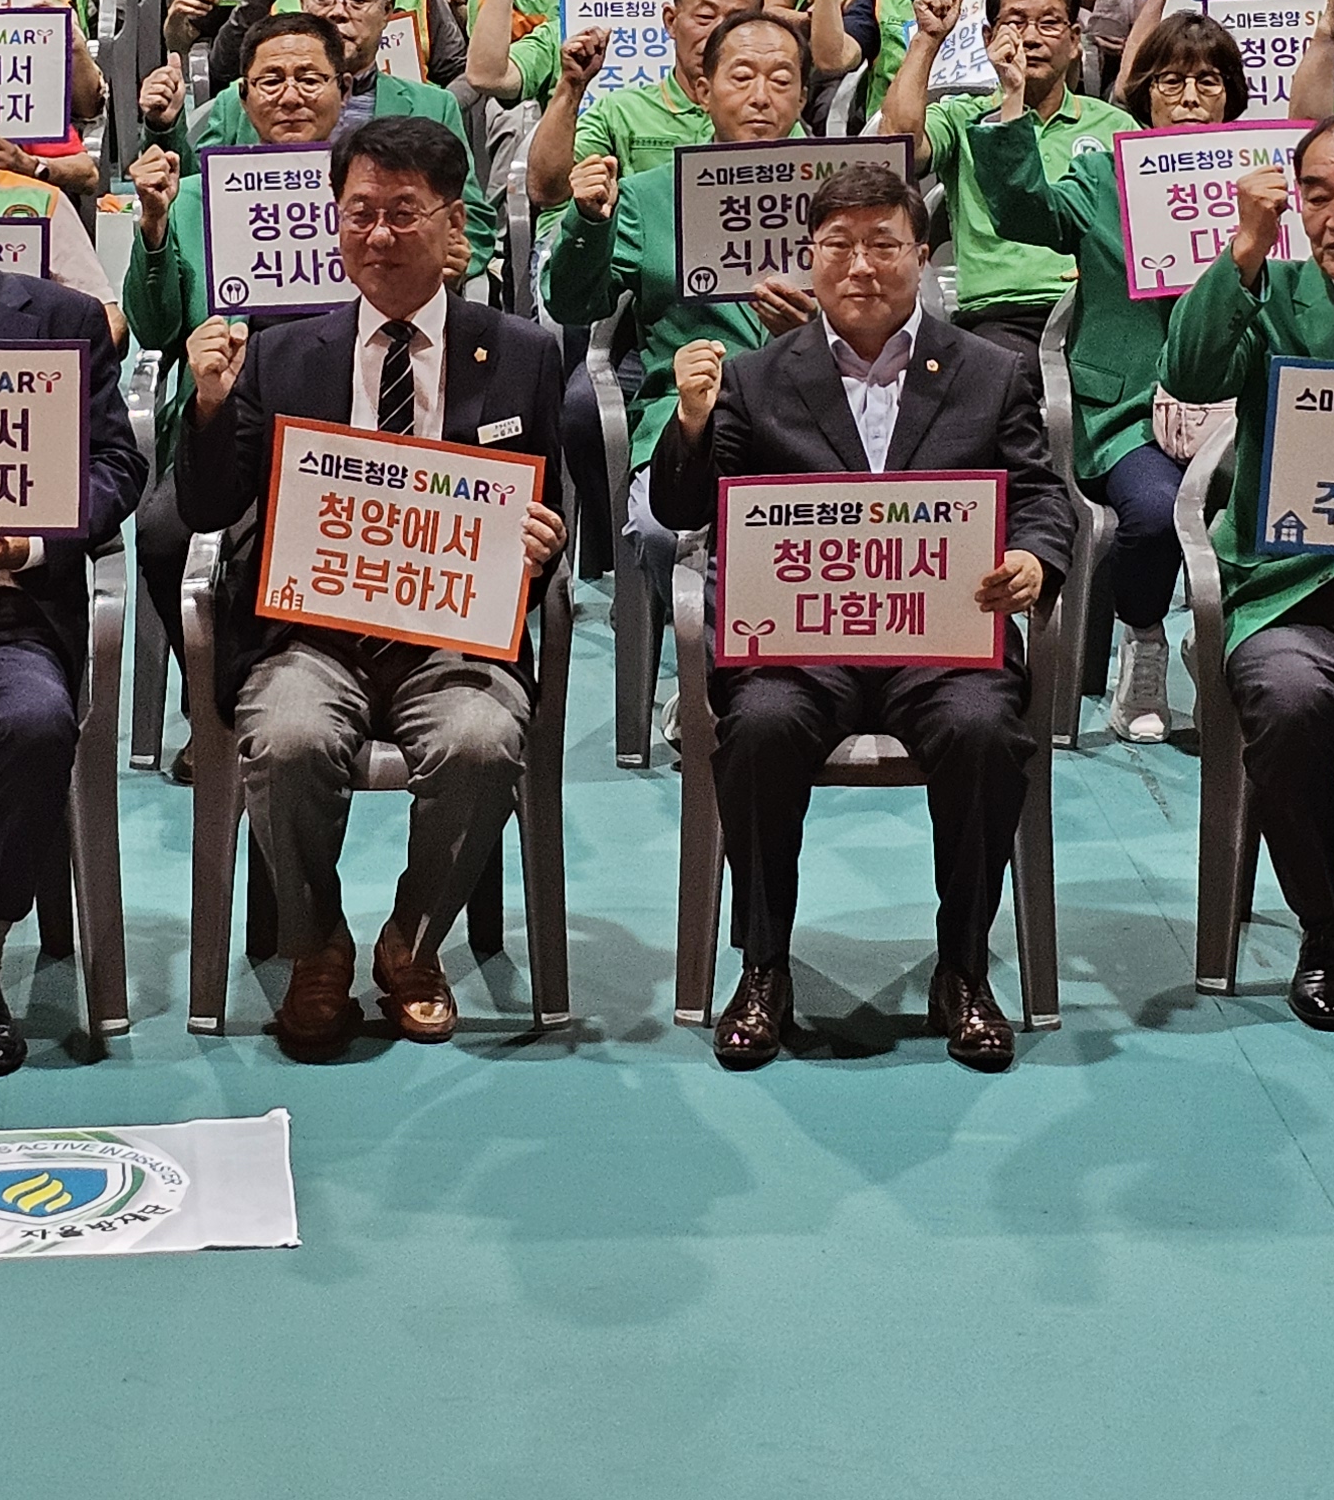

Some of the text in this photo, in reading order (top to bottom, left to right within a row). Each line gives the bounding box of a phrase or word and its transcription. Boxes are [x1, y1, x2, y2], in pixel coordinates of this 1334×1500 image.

[578, 1, 657, 18] 스마트청양
[1220, 9, 1301, 30] 스마트청양
[696, 161, 796, 187] 스마트청양
[1138, 148, 1234, 176] 스마트청양
[224, 169, 322, 193] 스마트청양
[297, 450, 409, 490] 스마트청양
[318, 490, 482, 562] 청양에서
[745, 501, 864, 528] 스마트청양
[773, 536, 949, 584] 청양에서
[310, 547, 477, 619] 공부하자
[796, 590, 926, 636] 다함께
[17, 1141, 98, 1152] ACTIVE
[99, 1142, 123, 1156] IN
